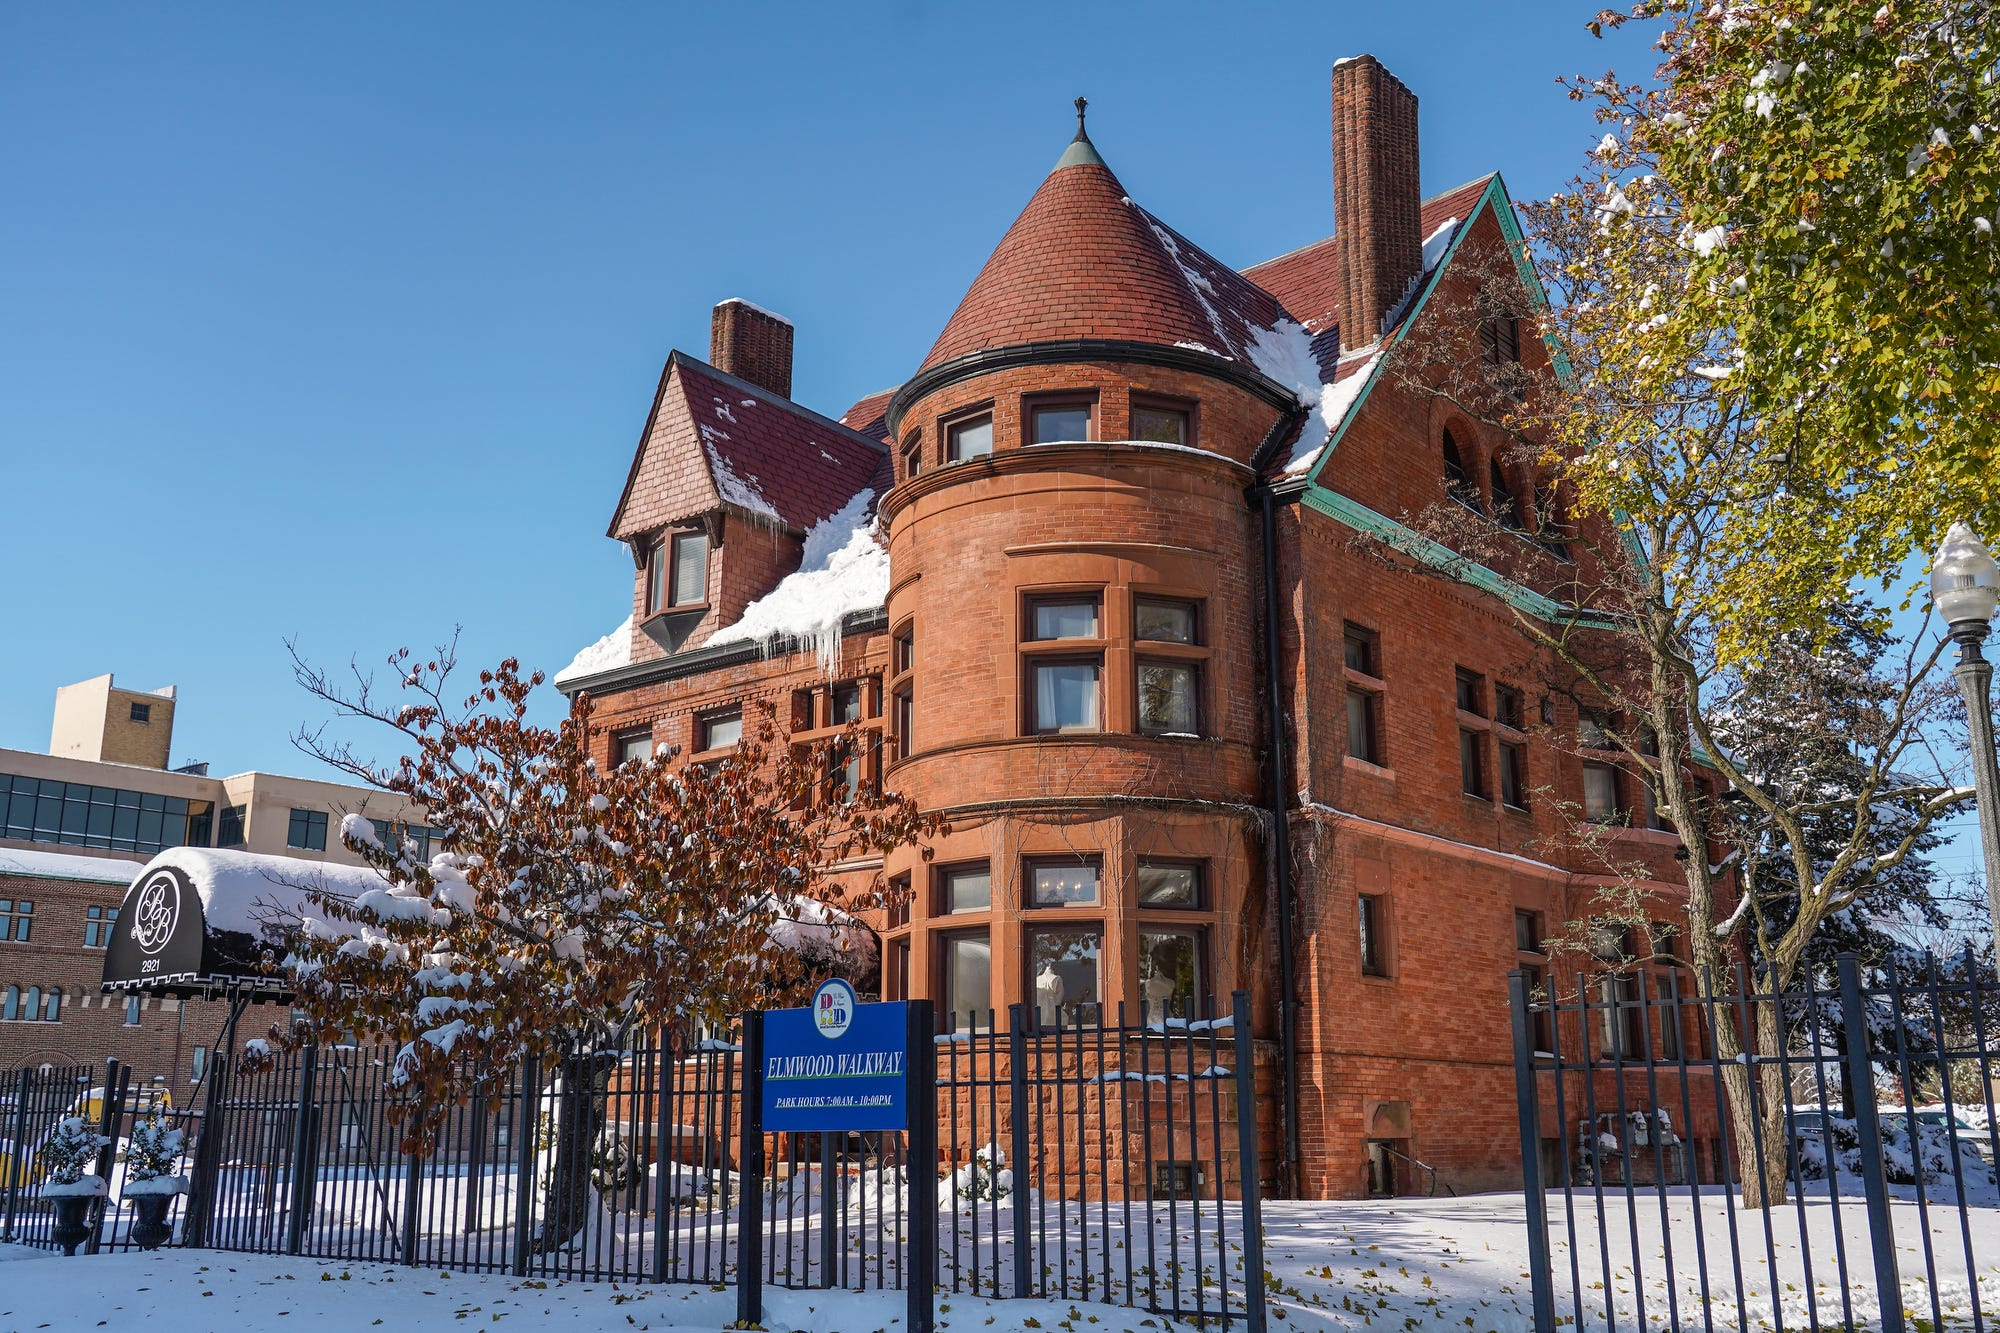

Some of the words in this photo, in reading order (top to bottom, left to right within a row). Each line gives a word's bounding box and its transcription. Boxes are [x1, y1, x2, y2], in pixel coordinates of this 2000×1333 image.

[141, 959, 160, 973] 2921
[767, 1055, 834, 1079] ELMWOOD
[837, 1051, 903, 1076] WALKWAY
[776, 1097, 797, 1108] PARK
[797, 1096, 825, 1108] HOURS
[826, 1095, 854, 1107] 7:00AM
[859, 1094, 892, 1106] 10:00PM
